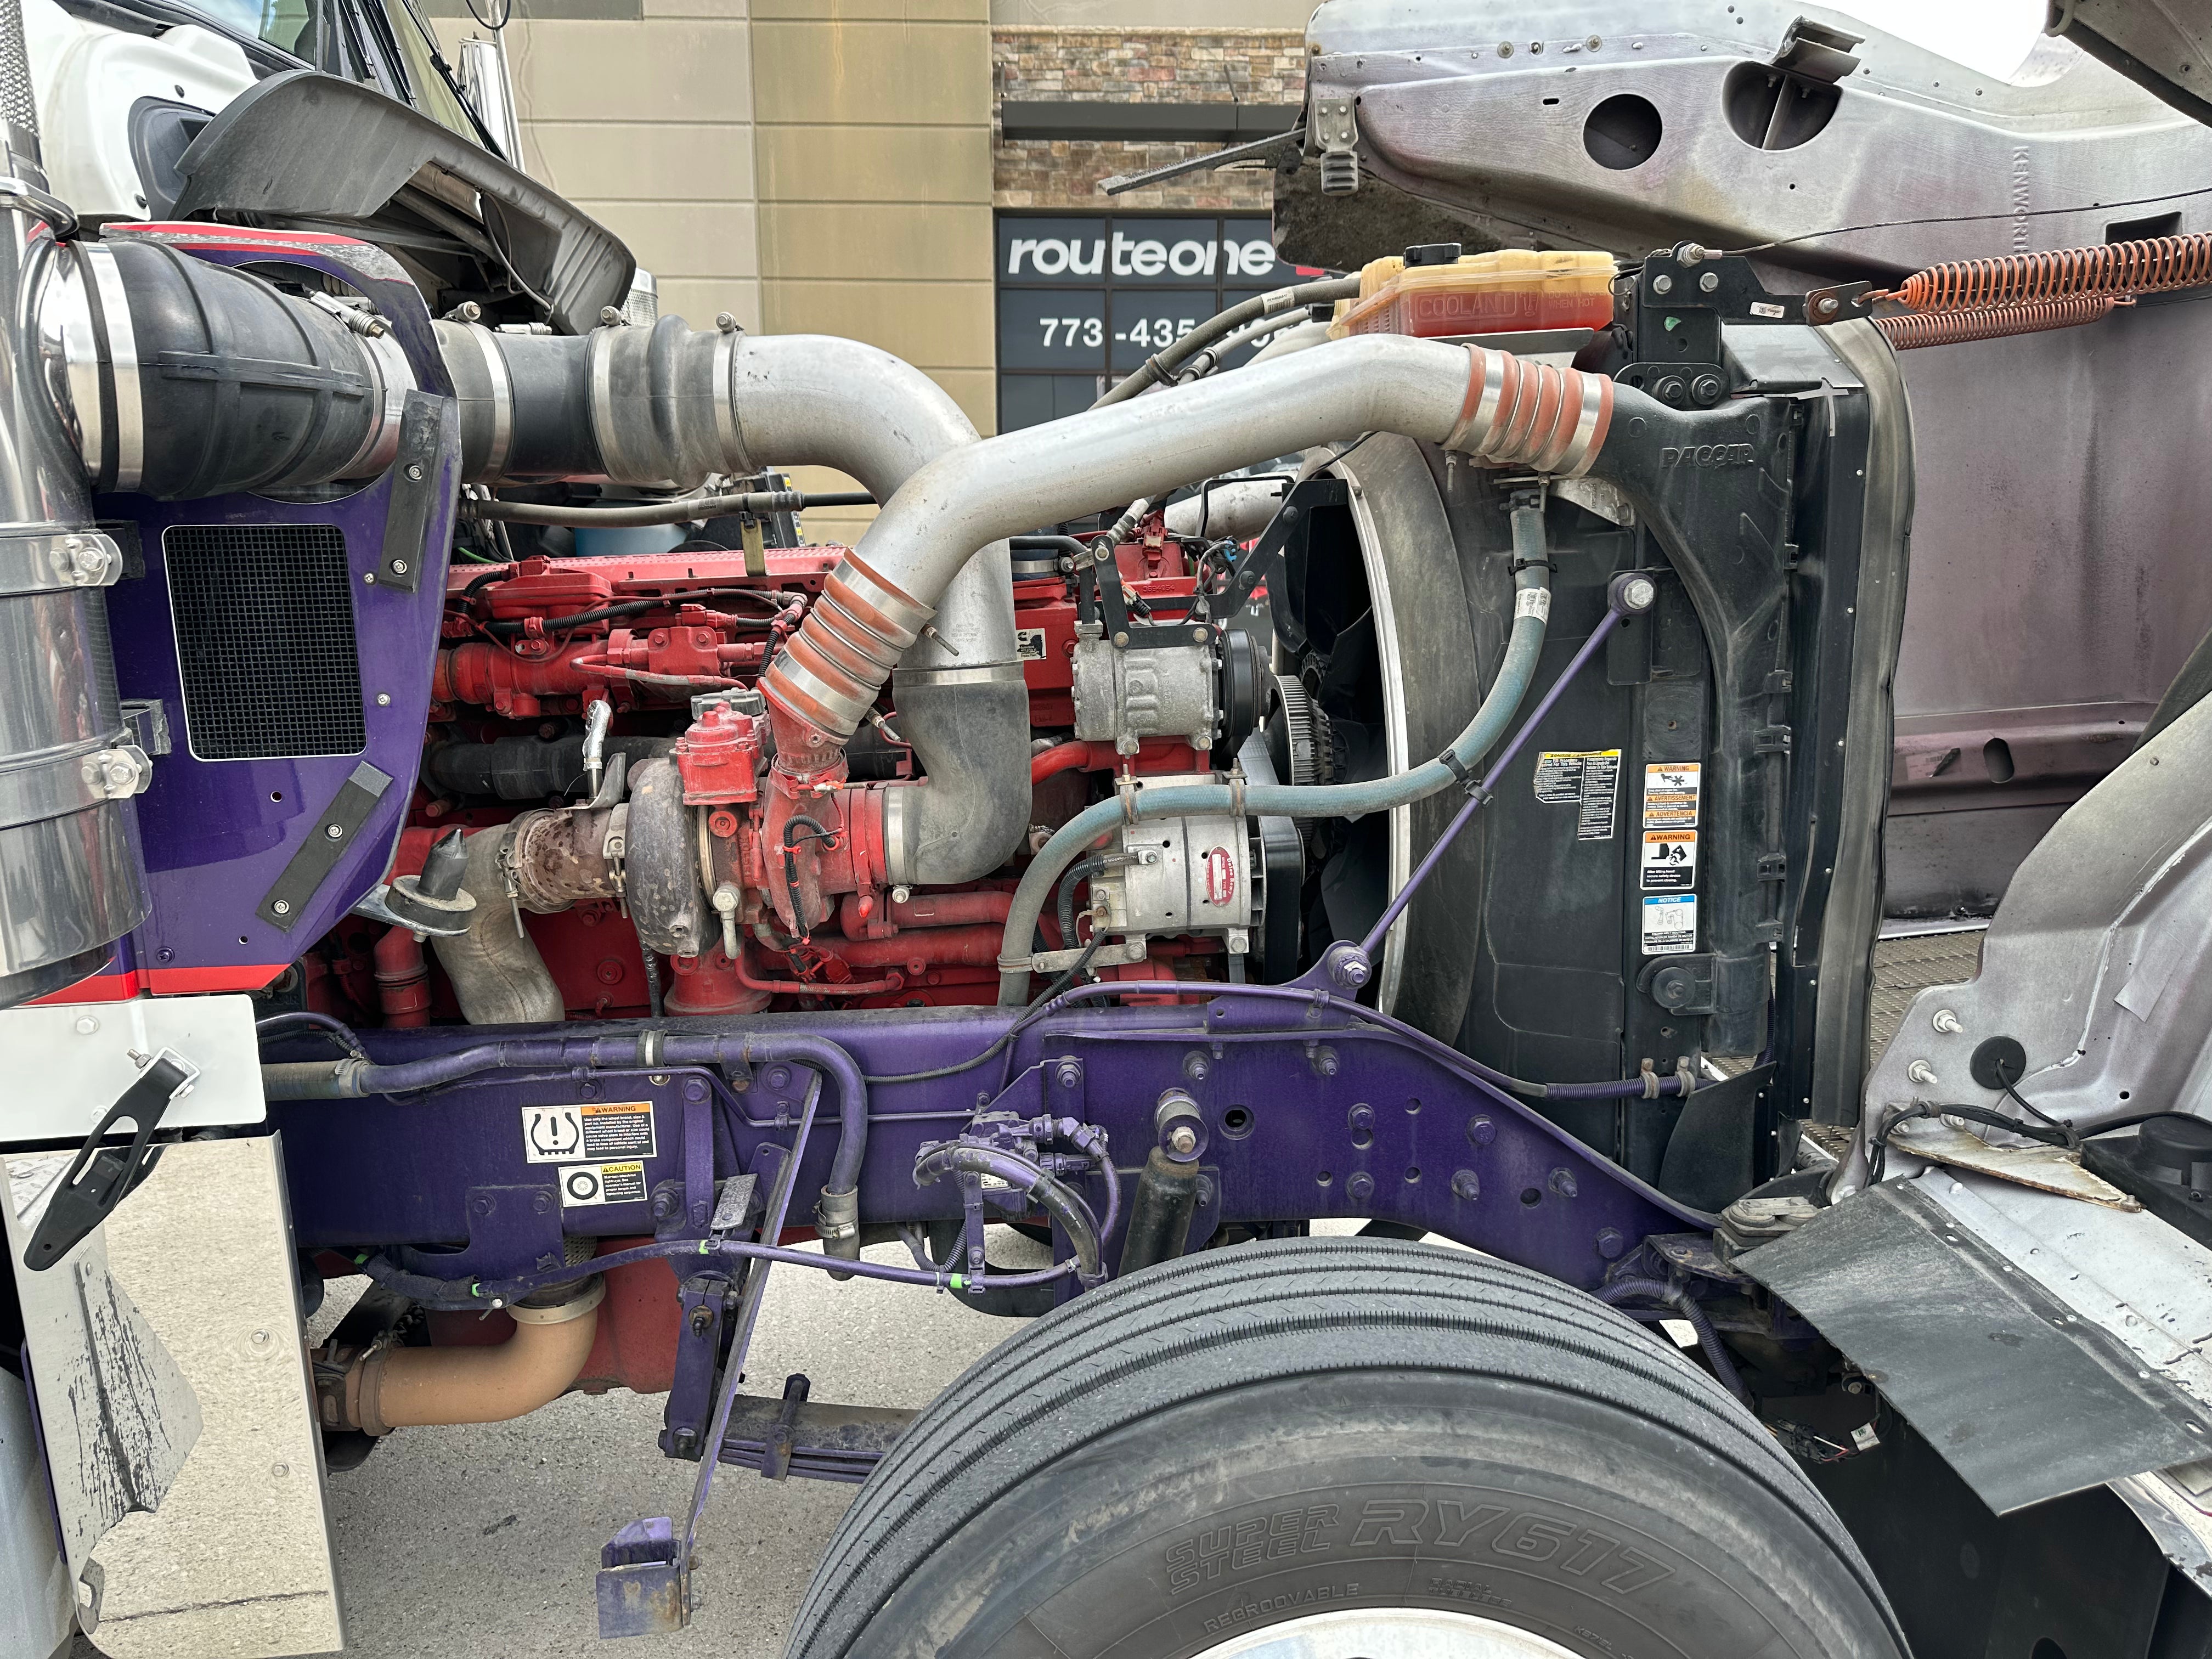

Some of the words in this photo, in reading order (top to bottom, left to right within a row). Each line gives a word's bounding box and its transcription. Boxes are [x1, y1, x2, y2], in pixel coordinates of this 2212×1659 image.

[1419, 294, 1511, 317] COOLANT
[1549, 290, 1561, 299] DO
[1566, 290, 1585, 298] NOT
[1549, 300, 1573, 309] WHEN
[1578, 298, 1595, 307] HOT
[1040, 318, 1103, 347] 773
[1660, 443, 1754, 468] PACCAR
[1166, 1503, 1340, 1572] SUPER
[1350, 1499, 1675, 1594] RY617
[1171, 1529, 1330, 1595] STEEL
[1430, 1577, 1492, 1594] RADIAL
[1203, 1583, 1359, 1633] REGROOVABLE
